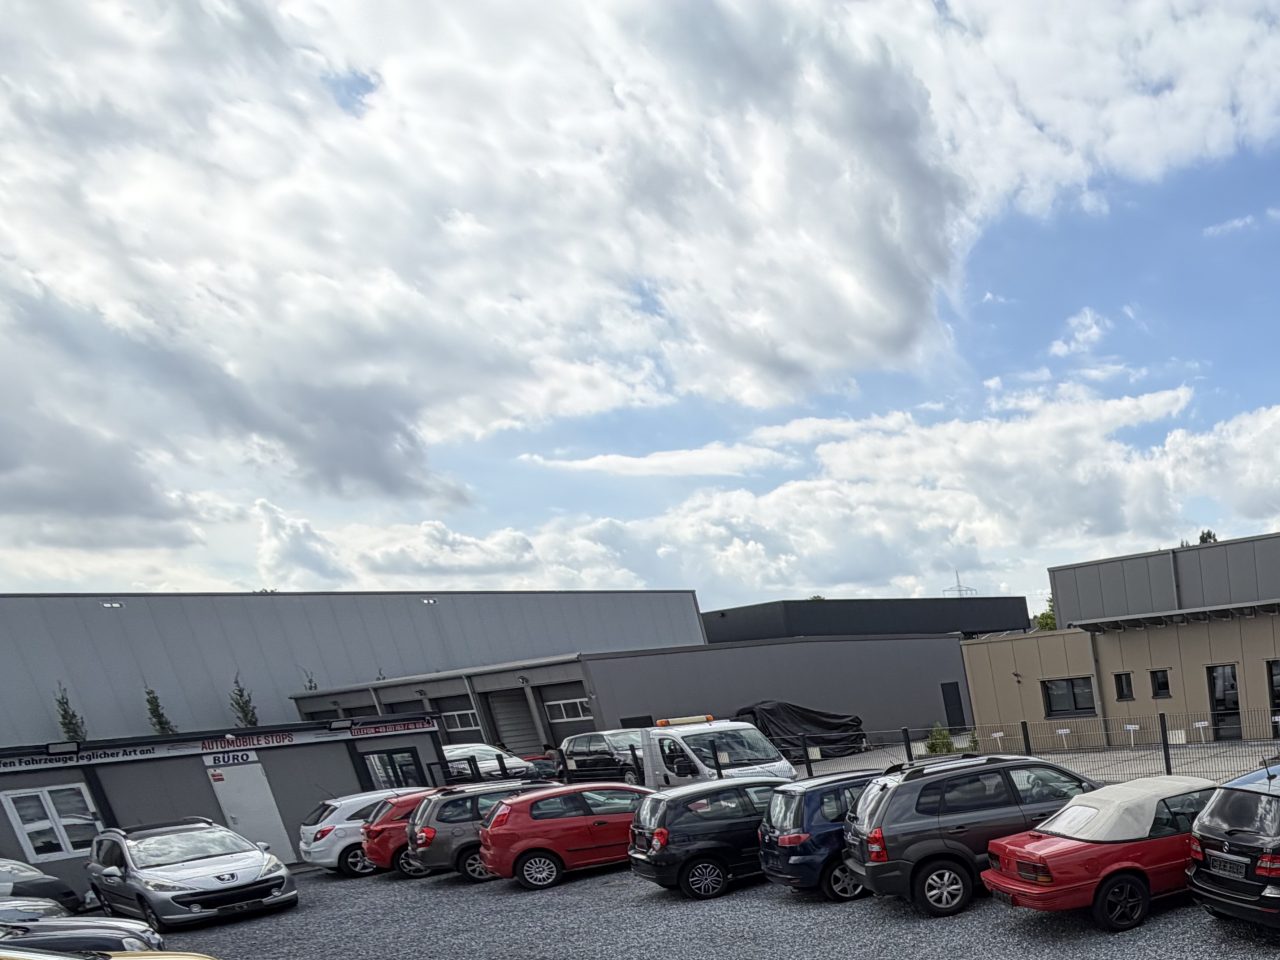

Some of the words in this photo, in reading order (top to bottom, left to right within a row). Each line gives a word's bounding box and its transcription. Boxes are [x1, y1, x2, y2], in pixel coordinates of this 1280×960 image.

[201, 735, 261, 751] AUTOMOBILE
[264, 733, 294, 745] STOPS
[18, 755, 74, 766] Fahrzeuge
[75, 750, 120, 763] jeglicher
[122, 748, 138, 757] Art
[139, 746, 156, 755] an!
[213, 752, 250, 765] BÜRO
